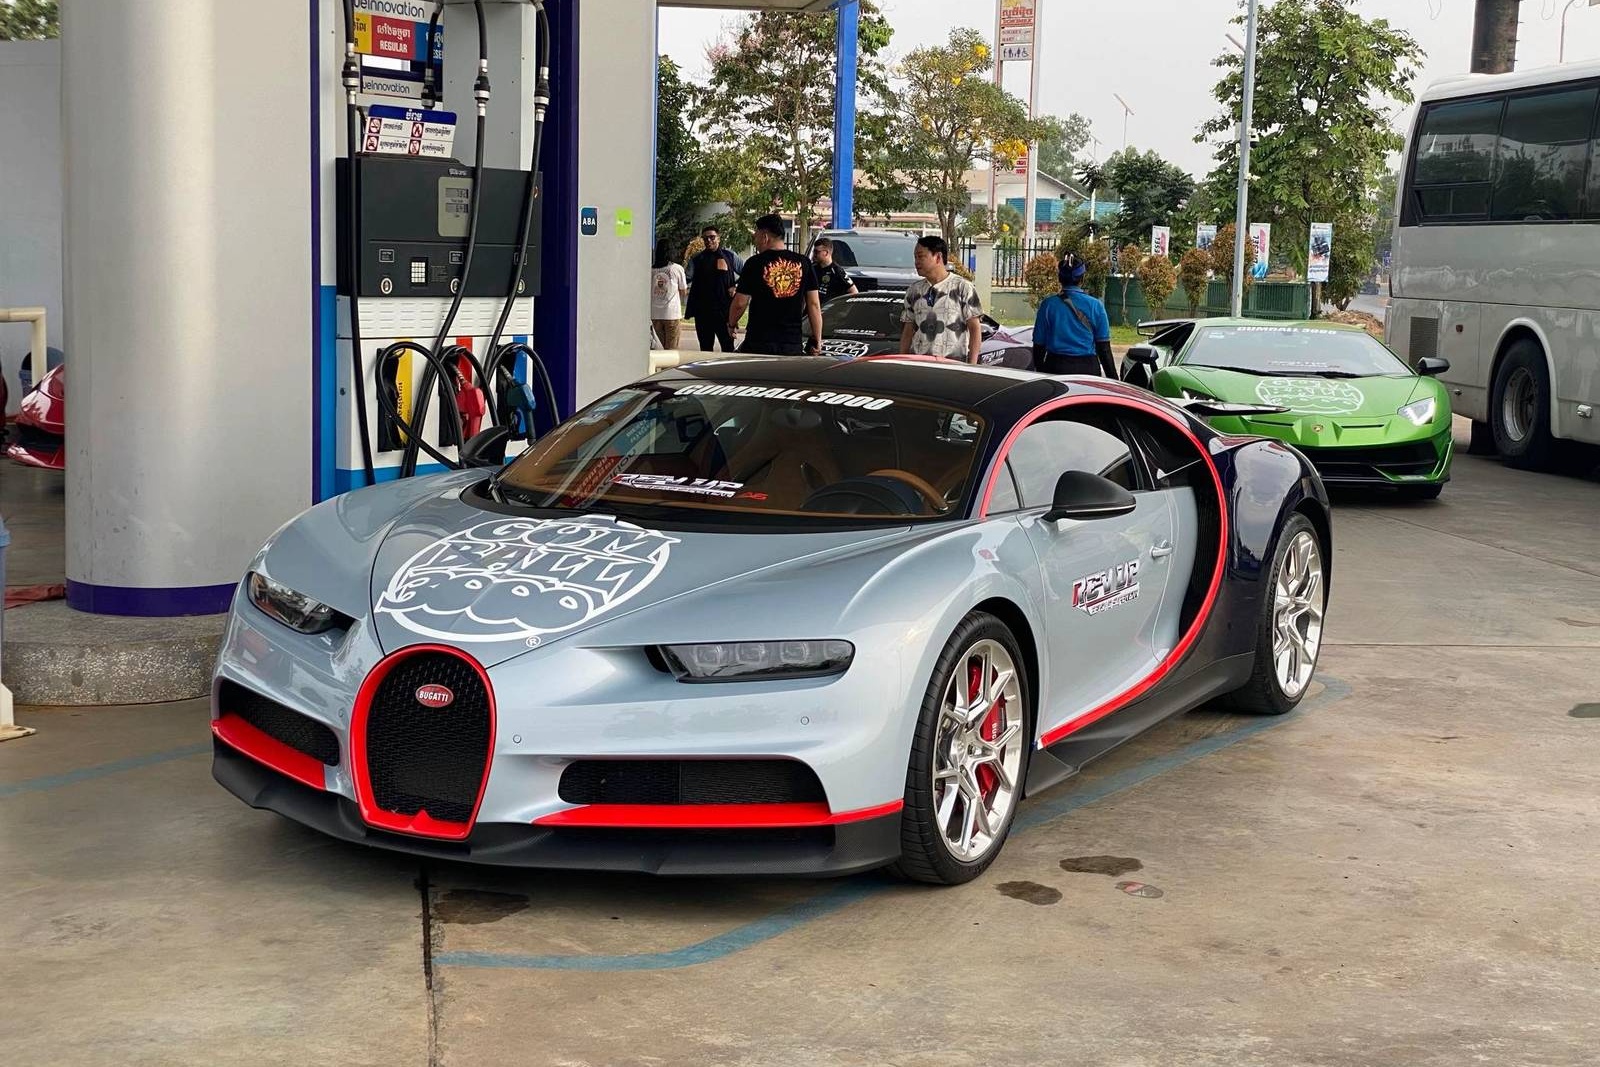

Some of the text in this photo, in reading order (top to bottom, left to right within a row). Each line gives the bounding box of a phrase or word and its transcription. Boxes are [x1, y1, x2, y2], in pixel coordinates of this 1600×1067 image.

[379, 40, 408, 53] REGULAR
[582, 217, 596, 225] ABA
[673, 384, 895, 411] GUMBALL 3000
[691, 478, 744, 490] UP
[1116, 558, 1141, 592] UP
[419, 690, 449, 702] BUGATTI
